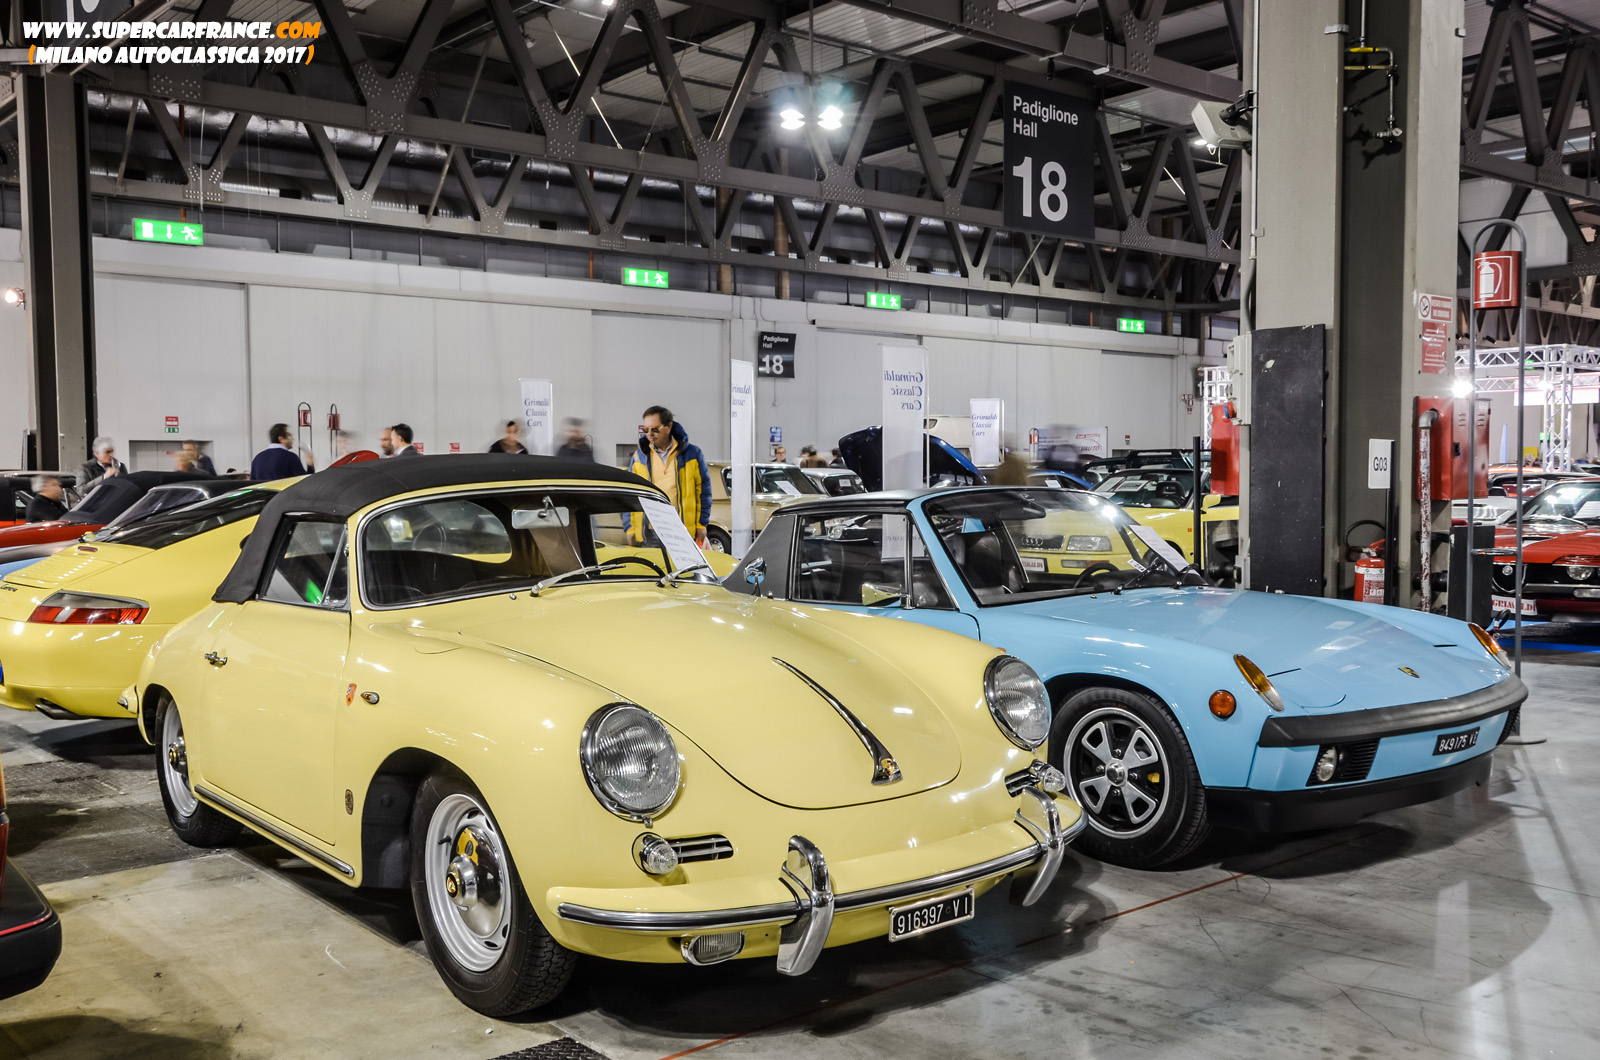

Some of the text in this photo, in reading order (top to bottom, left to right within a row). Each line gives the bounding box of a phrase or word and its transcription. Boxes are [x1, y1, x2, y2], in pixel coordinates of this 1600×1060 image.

[1013, 95, 1078, 125] Padiglione
[1013, 117, 1038, 138] Hall
[1012, 156, 1068, 222] 18
[763, 335, 789, 343] Padiglione
[761, 354, 784, 375] 18
[525, 409, 548, 417] Classic
[971, 413, 998, 421] Grimaldi
[526, 419, 543, 428] Cars
[1373, 456, 1388, 472] G03
[1438, 734, 1468, 752] 849175
[897, 903, 944, 934] 916397
